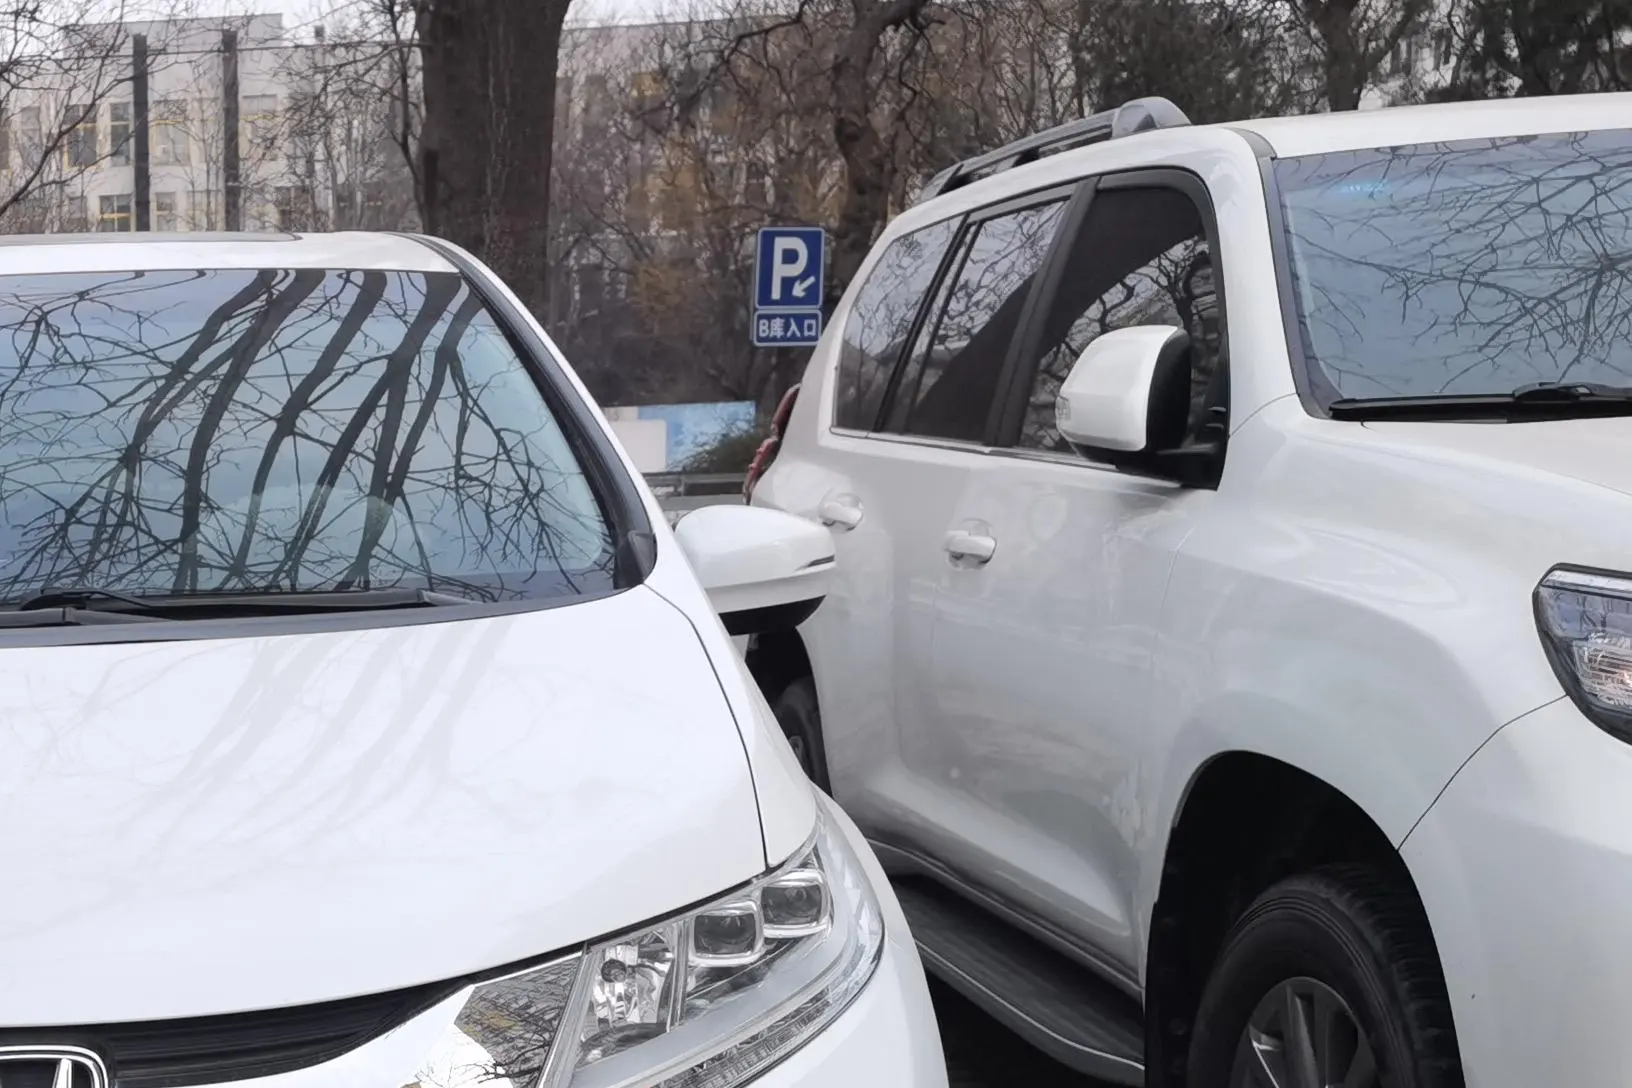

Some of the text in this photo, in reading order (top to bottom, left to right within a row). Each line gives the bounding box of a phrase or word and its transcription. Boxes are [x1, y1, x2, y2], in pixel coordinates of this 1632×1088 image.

[771, 236, 809, 300] P
[759, 317, 817, 338] B库入口
